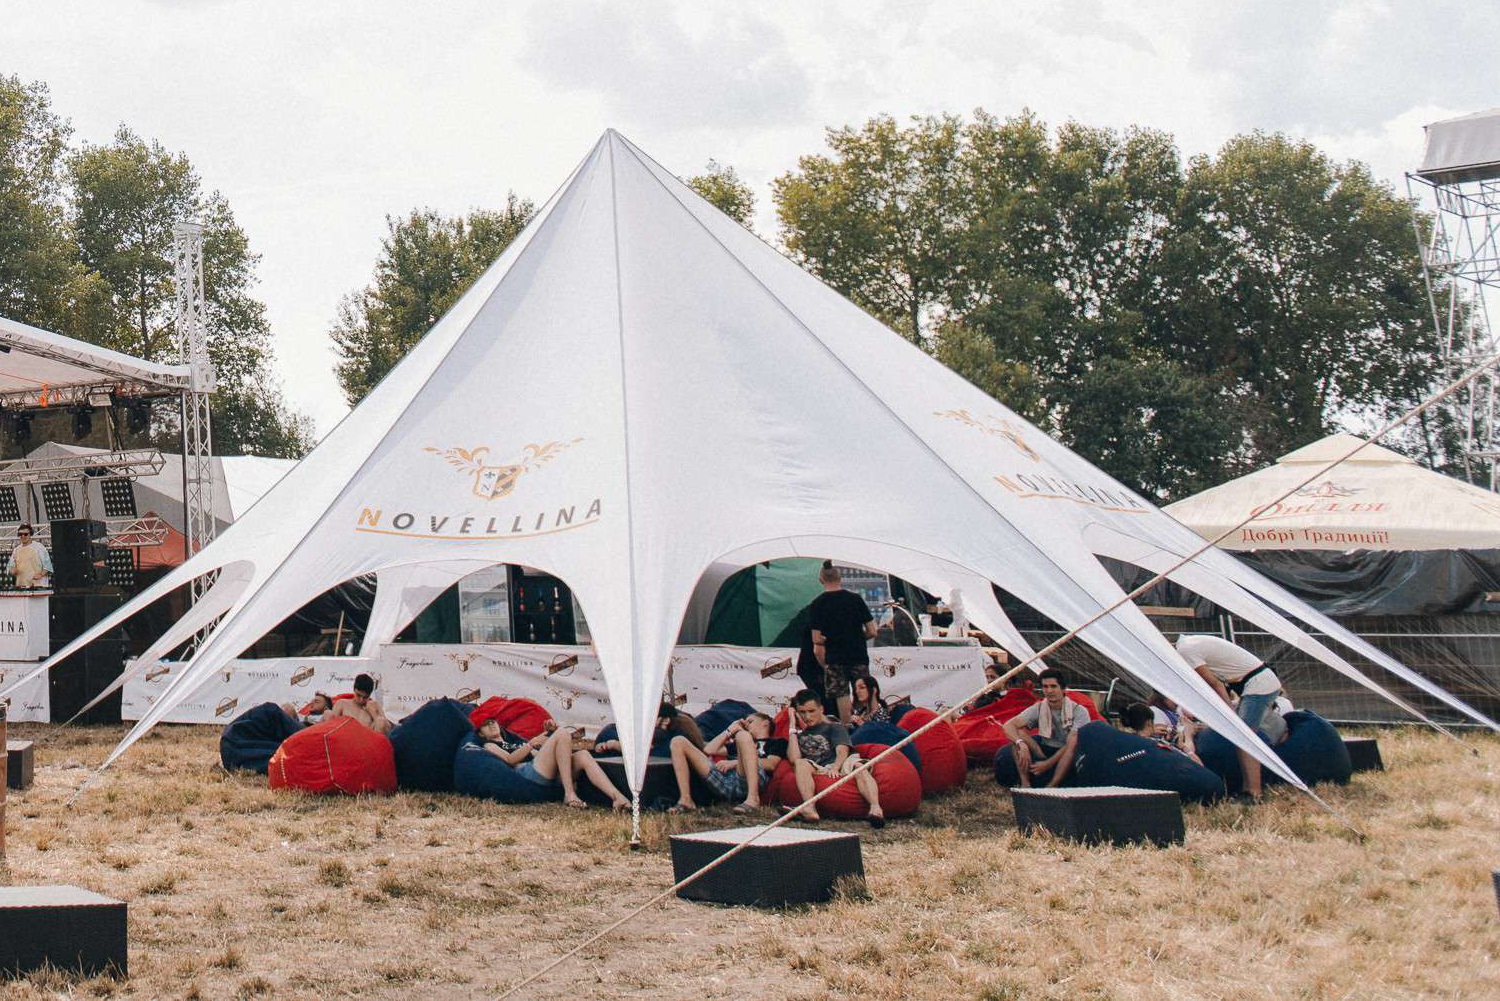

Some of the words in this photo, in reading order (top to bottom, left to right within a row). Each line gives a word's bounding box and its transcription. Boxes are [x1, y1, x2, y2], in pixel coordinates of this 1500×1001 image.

[356, 499, 601, 534] NOVELLINA
[1241, 528, 1295, 544] Добрі
[1300, 528, 1390, 544] Традиції!
